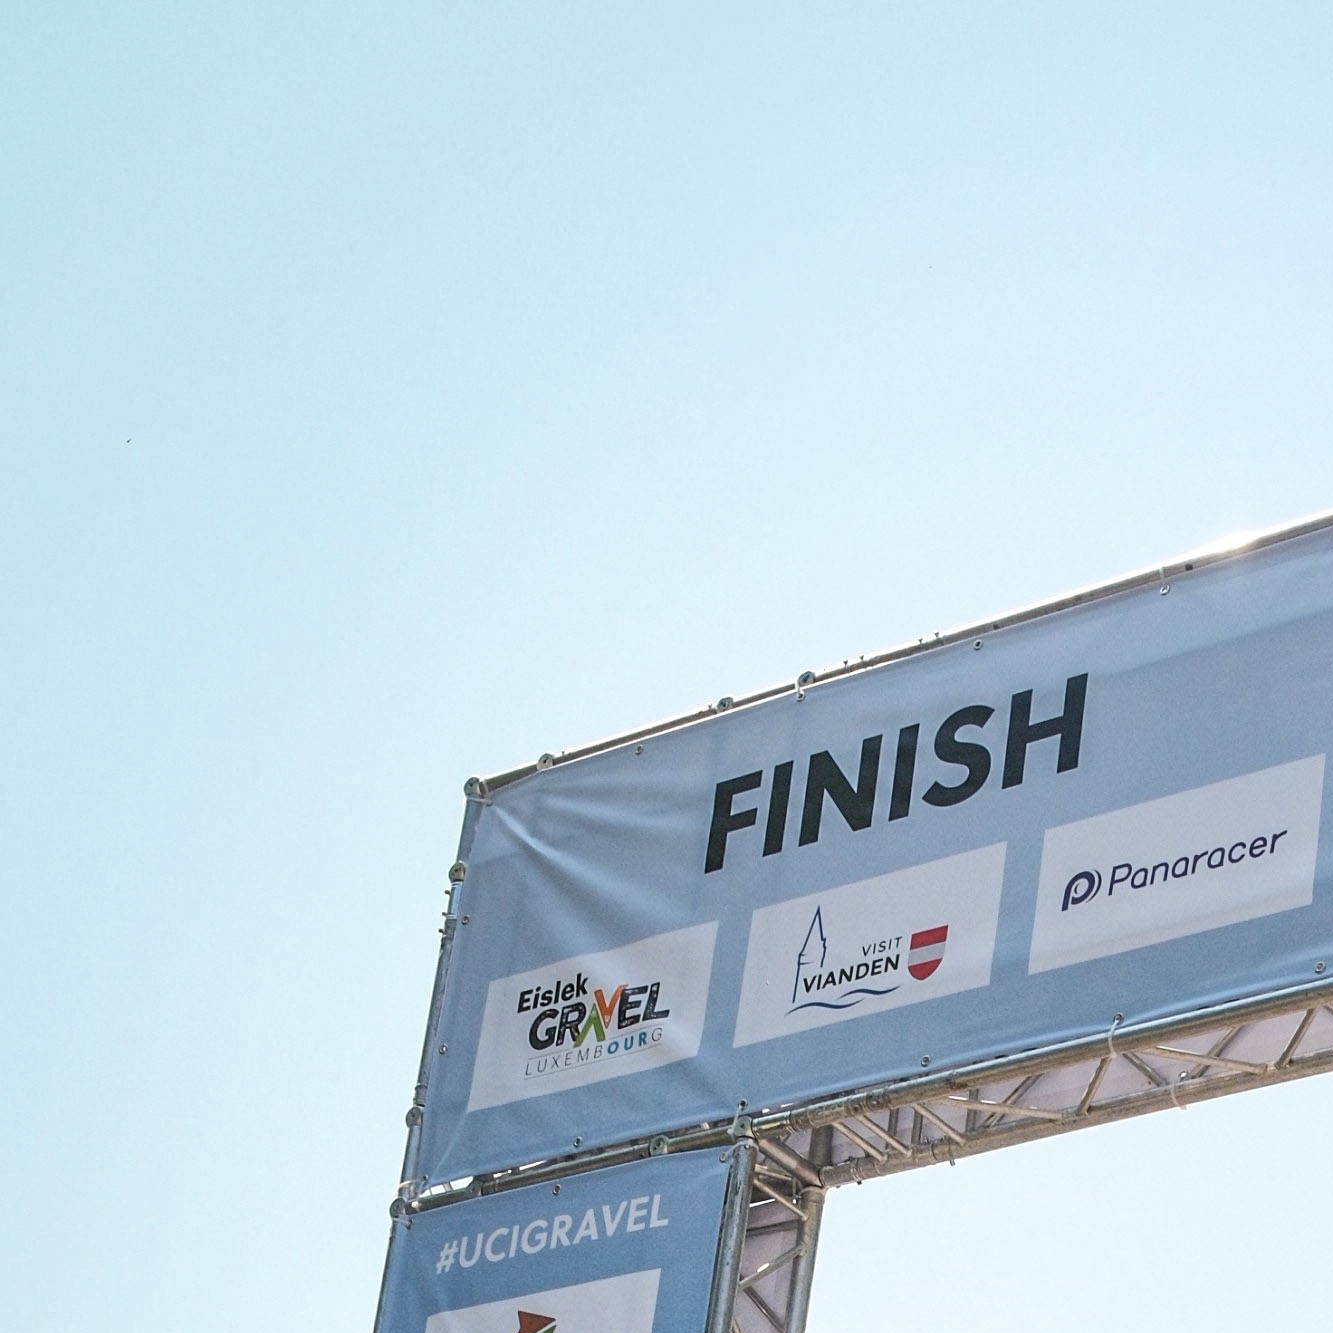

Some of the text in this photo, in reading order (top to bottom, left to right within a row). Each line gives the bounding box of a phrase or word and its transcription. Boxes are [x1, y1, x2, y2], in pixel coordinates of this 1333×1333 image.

[703, 672, 1090, 875] FINISH
[1106, 828, 1289, 897] Panaracer
[802, 956, 901, 993] VIANDEN
[861, 936, 903, 957] VISIT
[516, 972, 589, 1014] Eislek
[529, 980, 672, 1052] GRAVEL
[524, 1027, 664, 1078] LUXEMBOURG
[435, 1193, 669, 1275] #UCIGRAVEL
